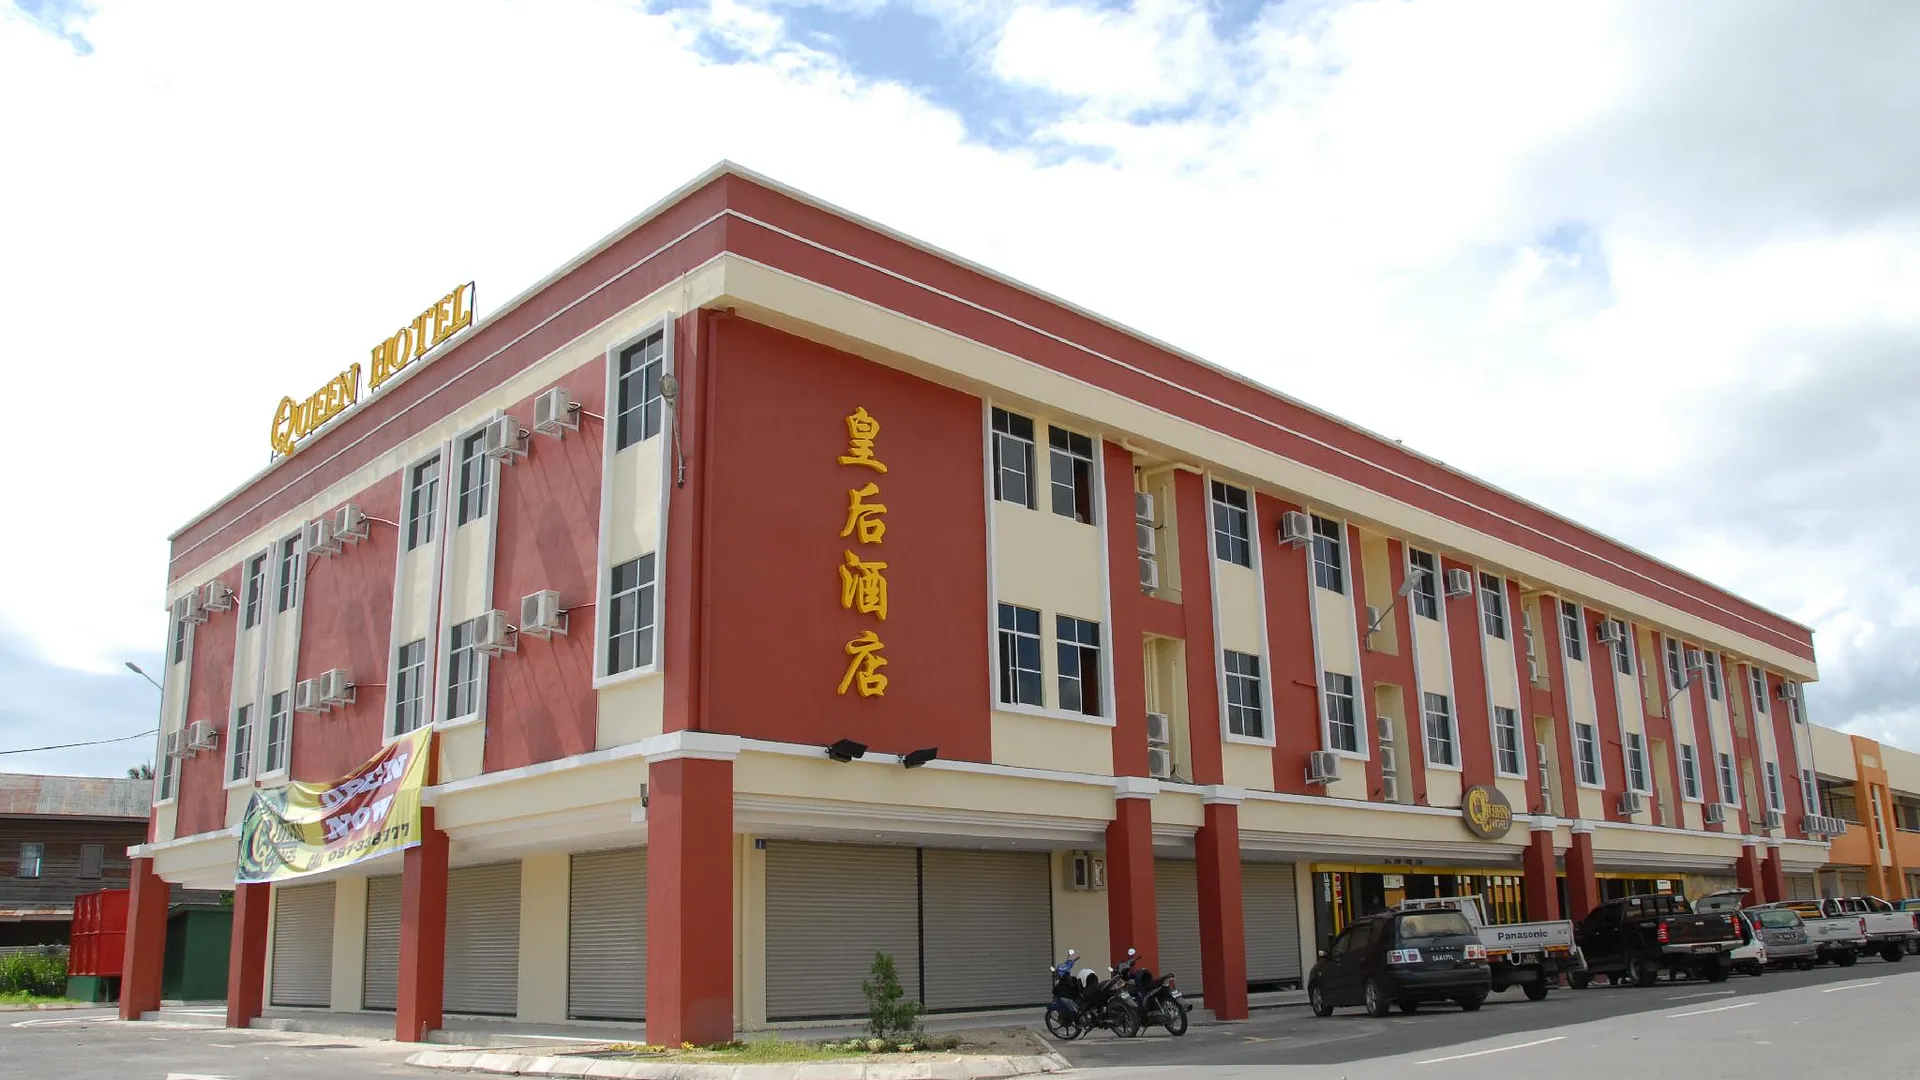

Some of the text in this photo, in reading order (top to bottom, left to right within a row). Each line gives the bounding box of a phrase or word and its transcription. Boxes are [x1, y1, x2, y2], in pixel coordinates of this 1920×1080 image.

[271, 284, 471, 456] QUEEN HOTEL
[837, 406, 889, 698] 皇后酒店
[321, 753, 408, 809] OPEN
[325, 793, 394, 840] NOW
[1497, 929, 1548, 941] Panasonic
